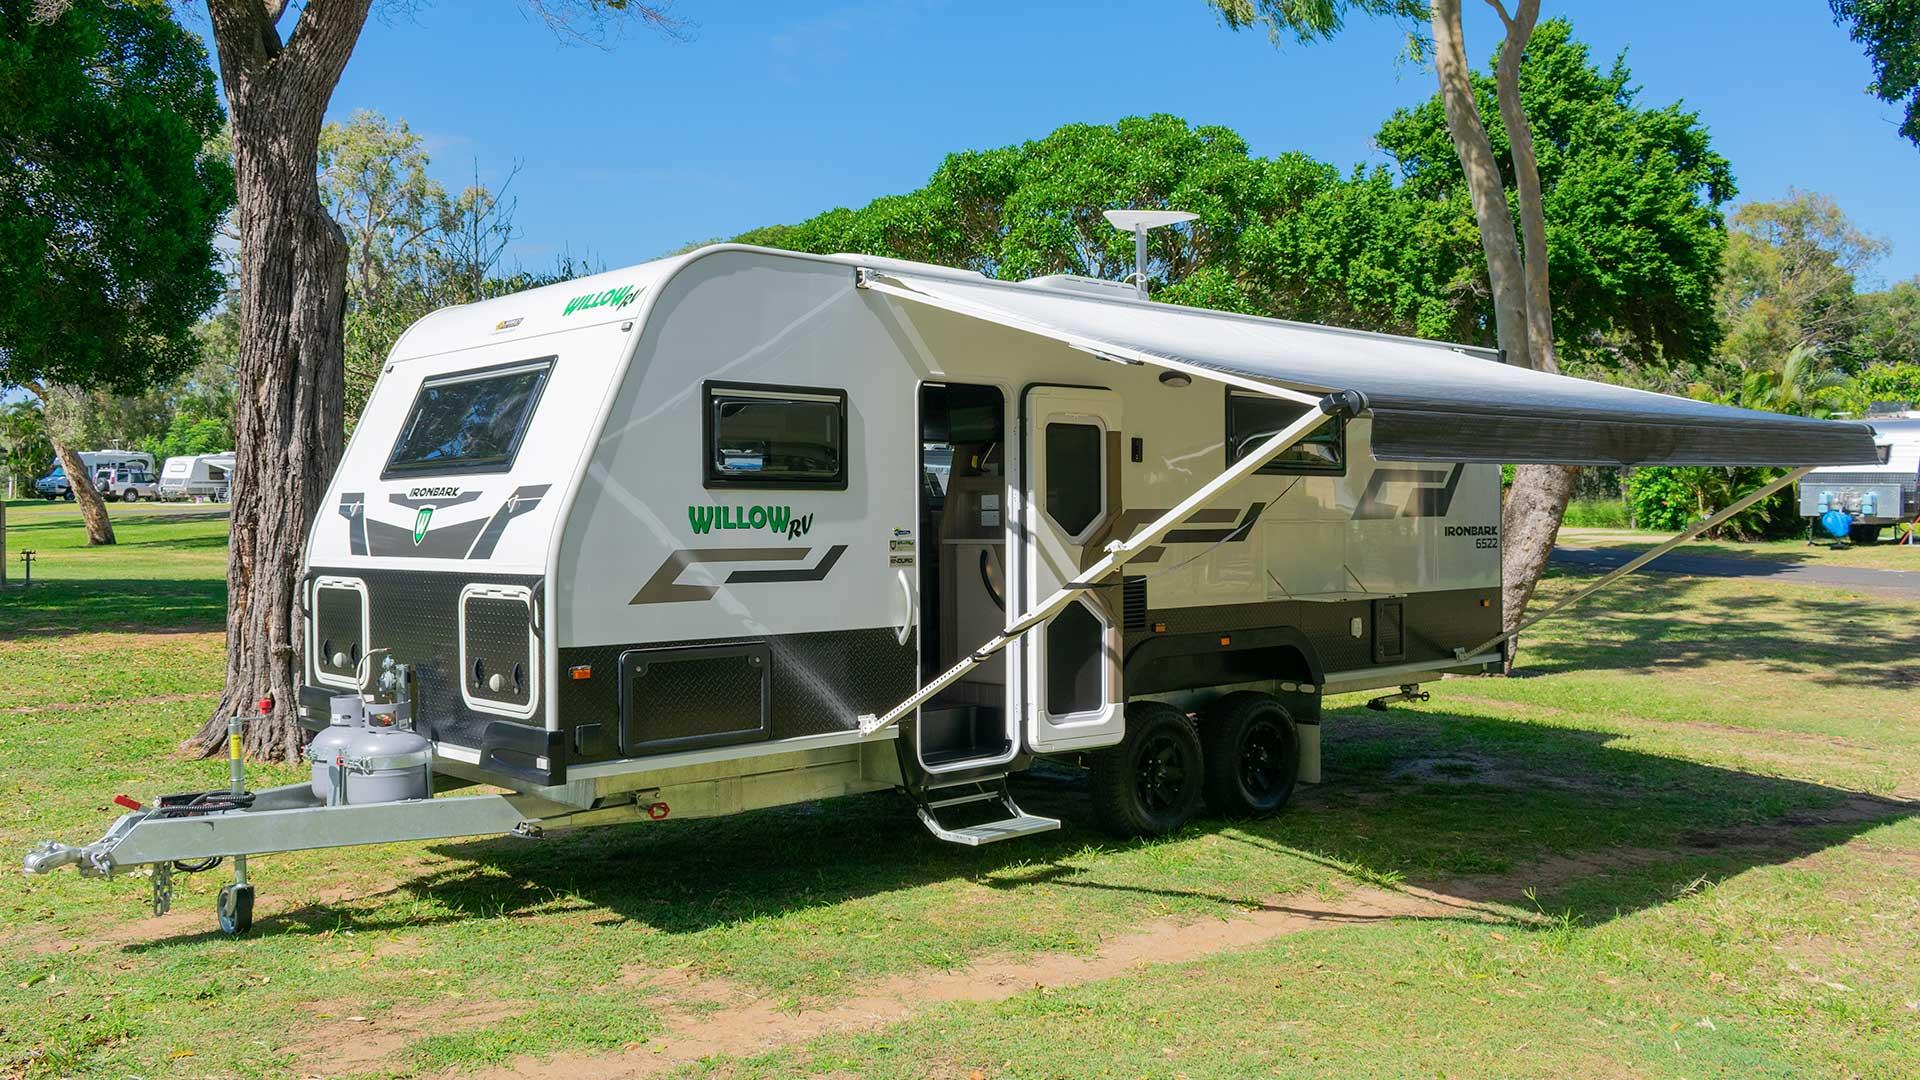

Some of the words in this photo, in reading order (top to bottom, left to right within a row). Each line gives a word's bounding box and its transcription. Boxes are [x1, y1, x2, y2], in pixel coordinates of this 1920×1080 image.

[562, 284, 634, 317] WILLOW
[409, 486, 460, 498] IRONBARK
[688, 505, 791, 534] WILLOW
[787, 513, 814, 541] RV
[1444, 526, 1498, 537] IRONBARK
[1475, 538, 1498, 549] 6522
